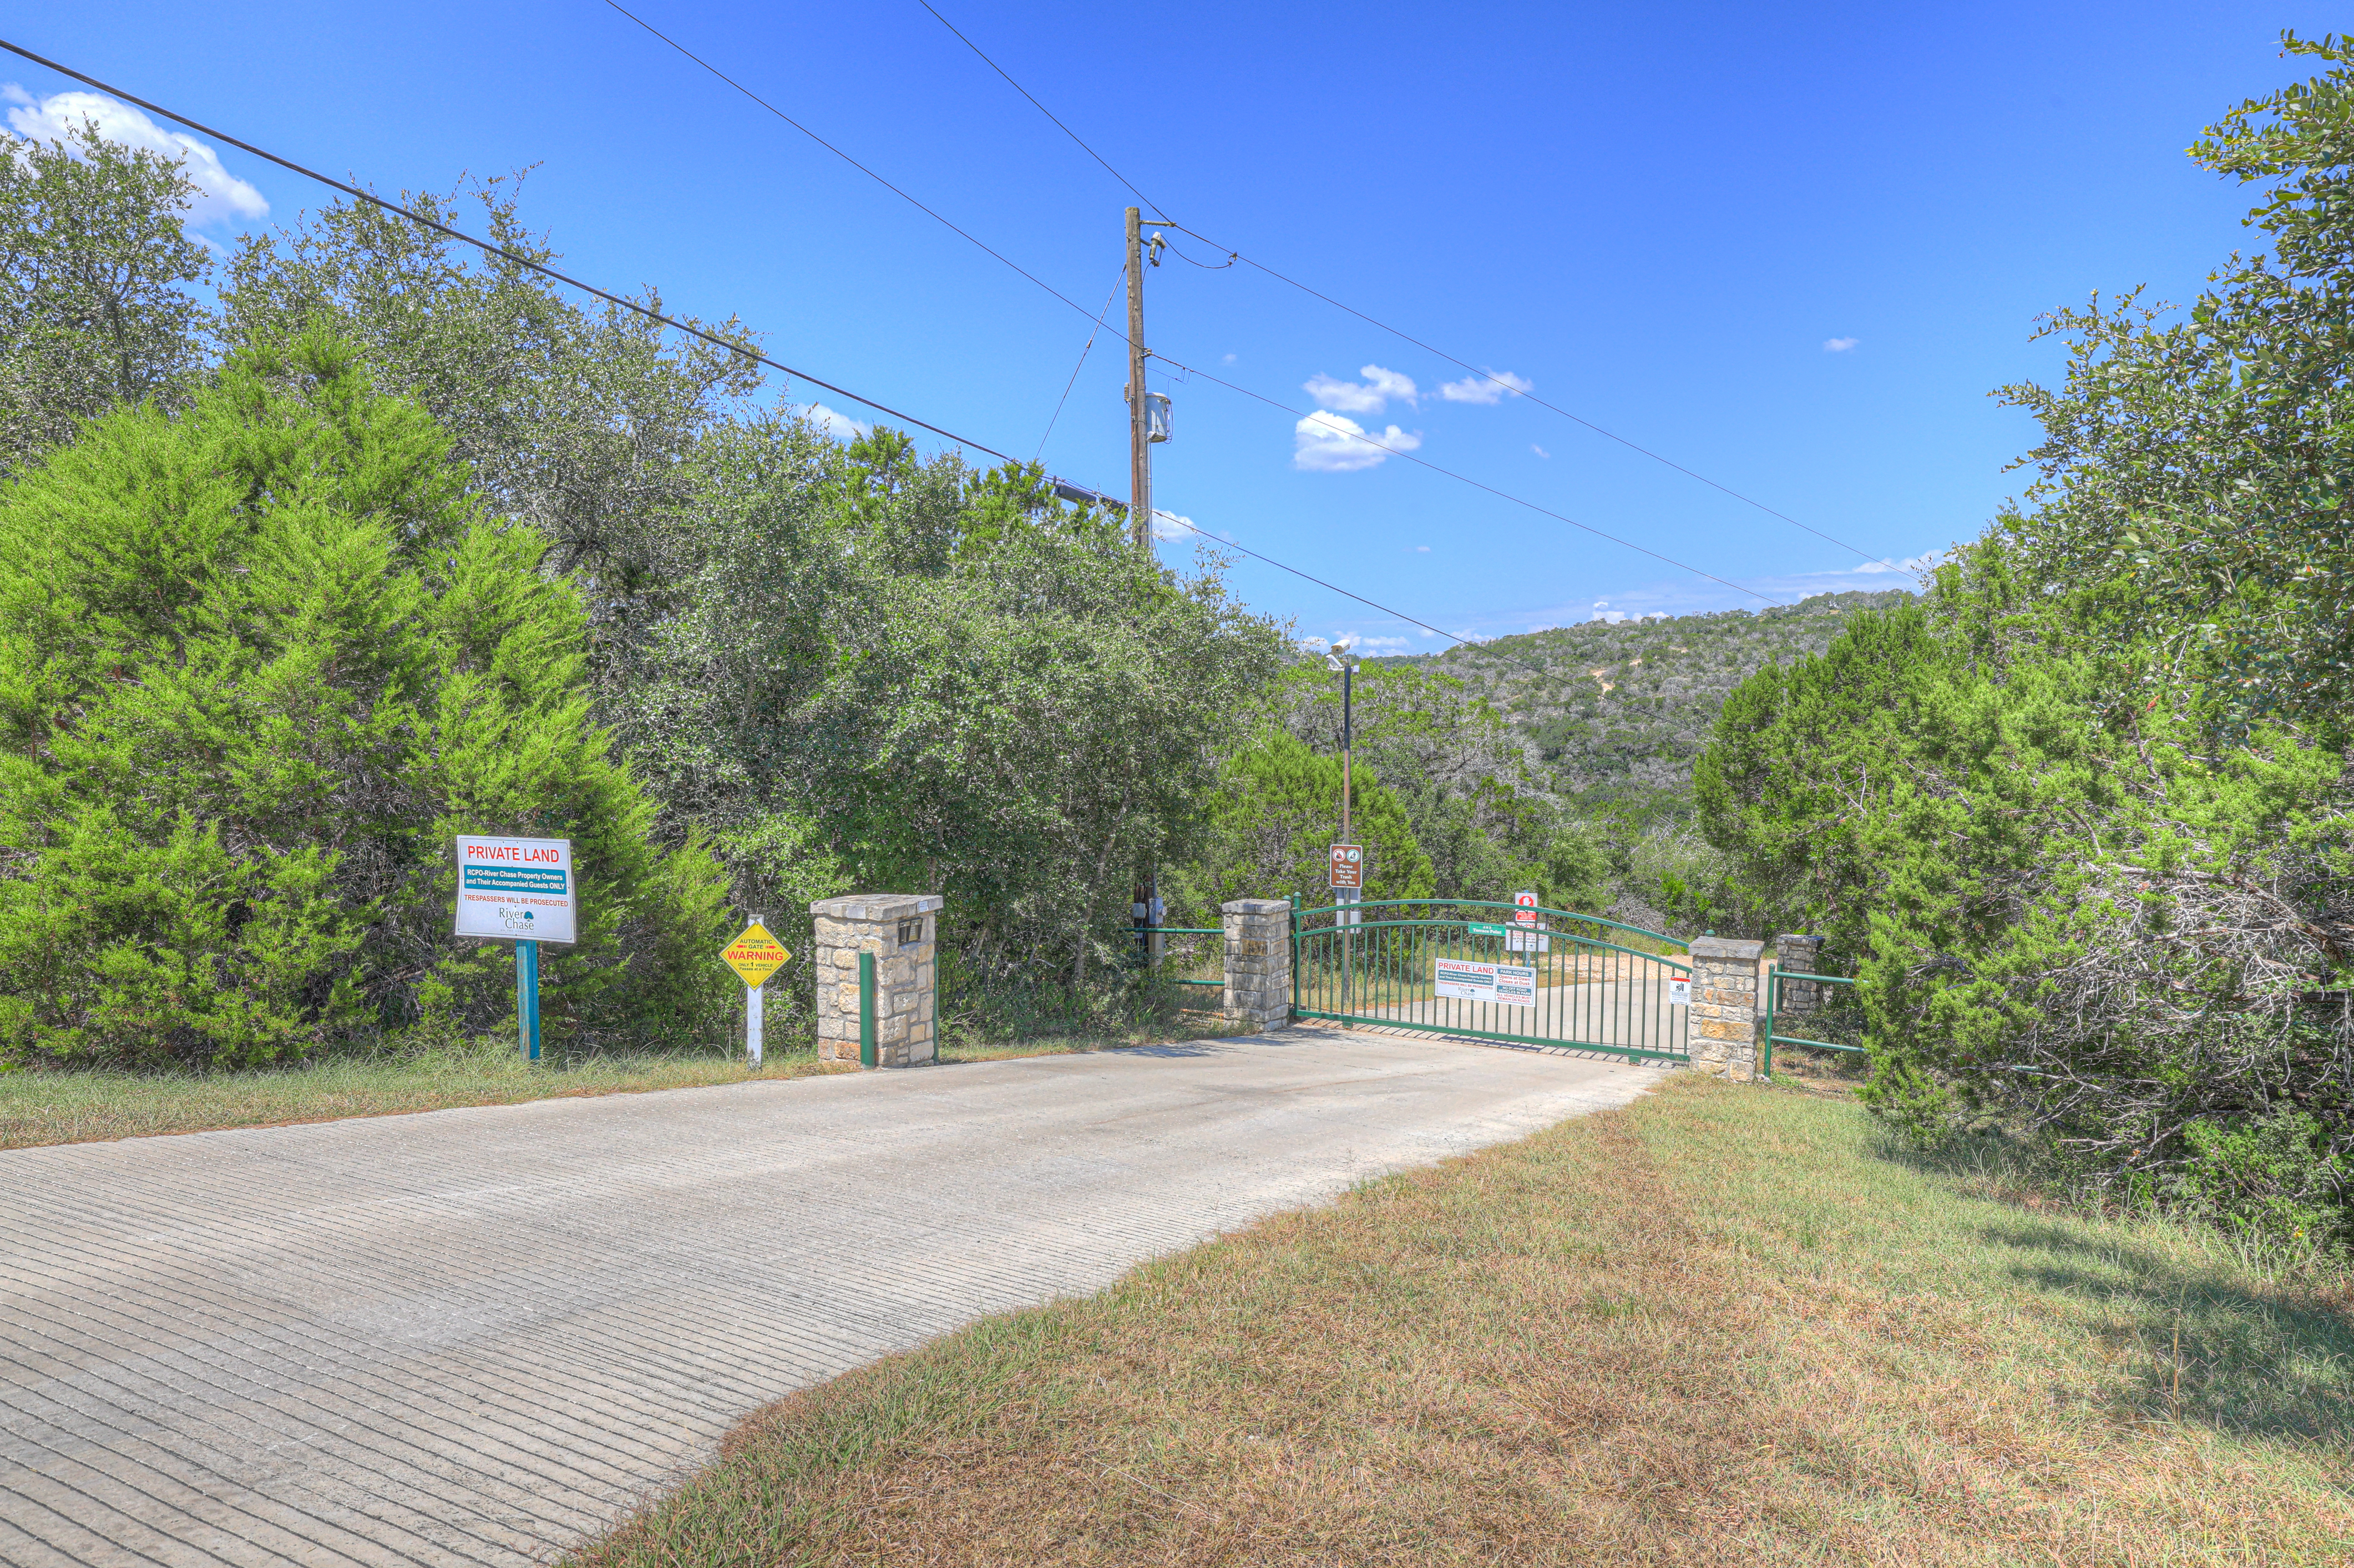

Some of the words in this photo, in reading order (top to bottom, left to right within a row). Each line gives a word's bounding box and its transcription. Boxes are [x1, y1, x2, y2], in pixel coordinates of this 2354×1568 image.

[468, 845, 520, 861] PRIVATE
[524, 848, 559, 862] LAND
[467, 869, 499, 877] RCPO-River
[518, 872, 540, 881] Property
[492, 879, 528, 888] Accompanied
[464, 894, 505, 903] TRESPASSERS
[530, 899, 568, 907] PROSECUTED
[499, 907, 524, 919] River
[505, 918, 534, 930] Chase
[727, 951, 783, 961] WARNING
[1439, 962, 1470, 972] PRIVATE
[1472, 966, 1494, 974] LAND
